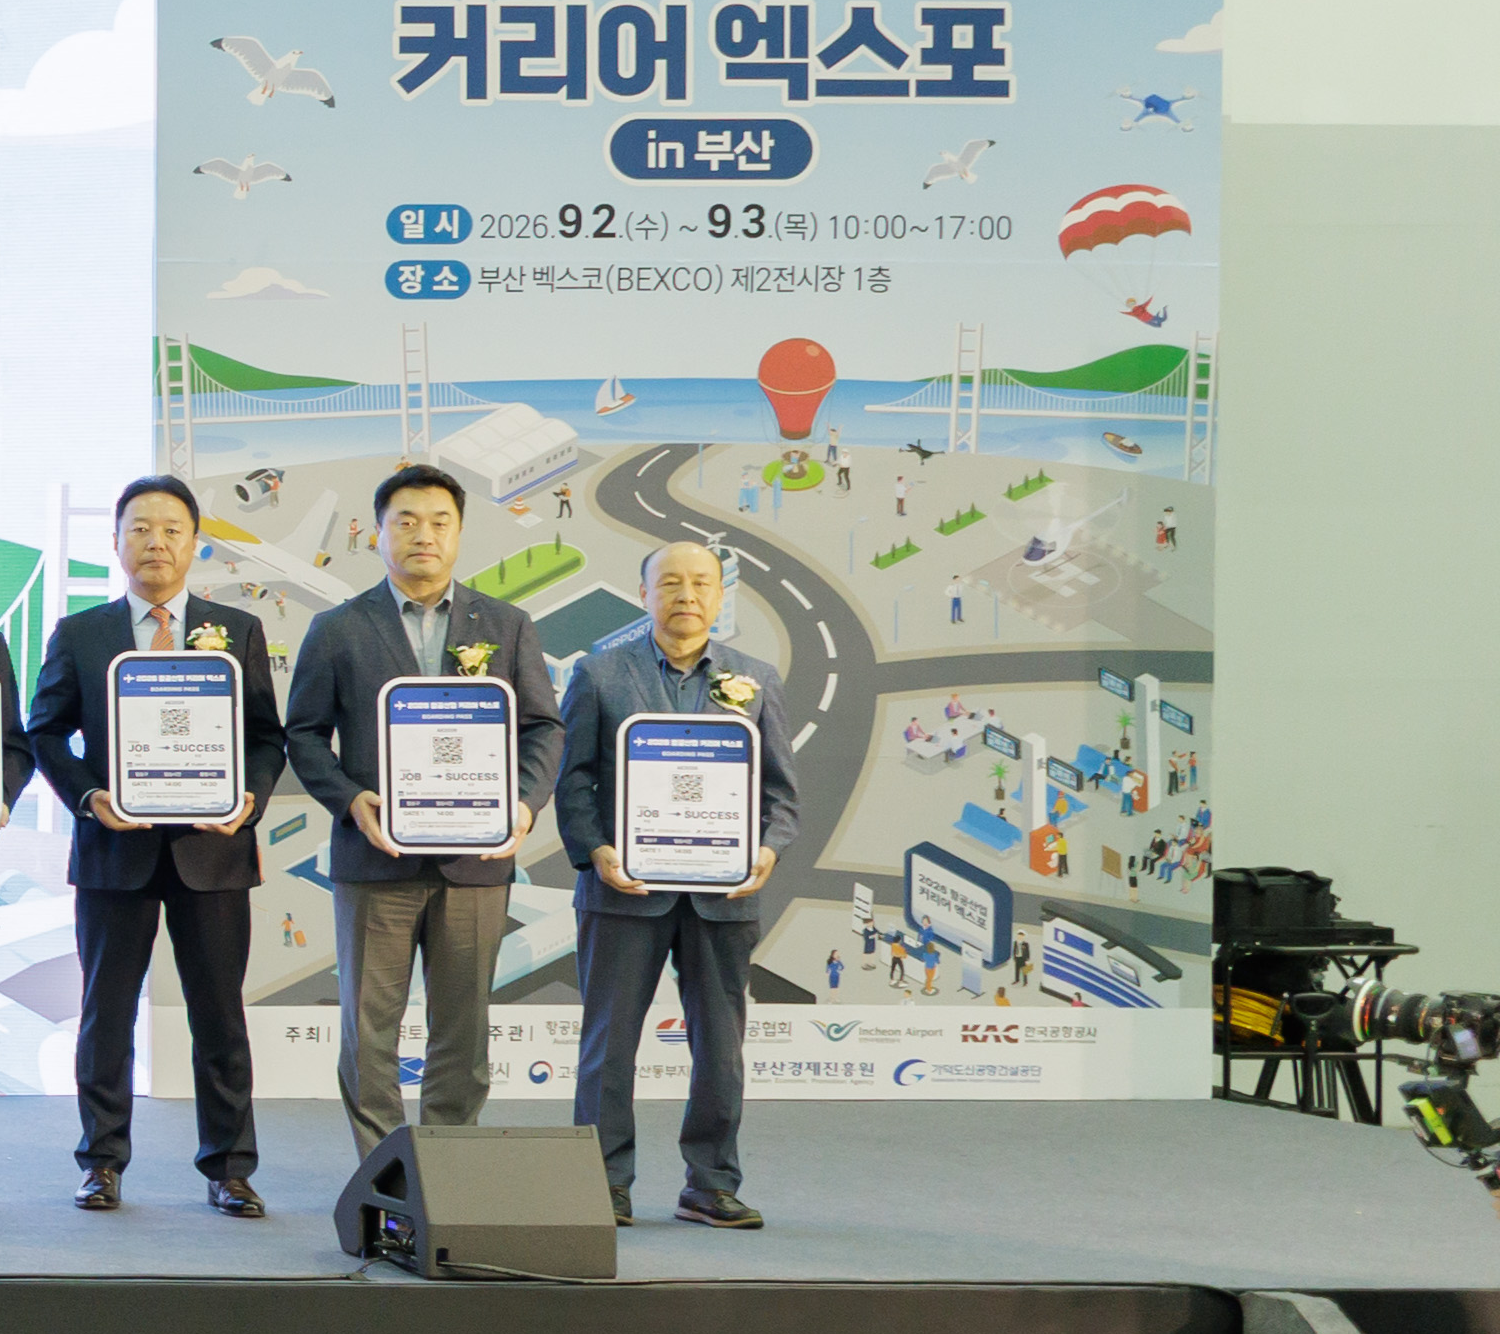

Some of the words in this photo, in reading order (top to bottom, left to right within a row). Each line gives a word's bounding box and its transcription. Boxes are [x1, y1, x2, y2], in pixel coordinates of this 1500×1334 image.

[396, 2, 688, 102] 커리어
[713, 3, 1011, 101] 엑스포
[646, 130, 685, 169] in
[694, 128, 775, 173] 부산
[828, 213, 1013, 241] 10:00~17:00
[477, 265, 527, 296] 부산
[532, 265, 724, 297] 벡스코(BEXCO)
[730, 265, 847, 296] 제2전시장
[854, 265, 893, 296] 1층
[127, 744, 150, 752] JOB
[173, 744, 225, 752] SUCCESS
[399, 772, 422, 780] JOB
[445, 772, 499, 781] SUCCESS
[636, 809, 659, 817] JOB
[684, 810, 740, 820] SUCCESS
[859, 1026, 901, 1036] Incheon
[905, 1027, 943, 1038] Airport
[961, 1024, 1019, 1043] KAC
[1025, 1026, 1097, 1038] 한국공항공사
[753, 1061, 875, 1077] 부산경제진흥원
